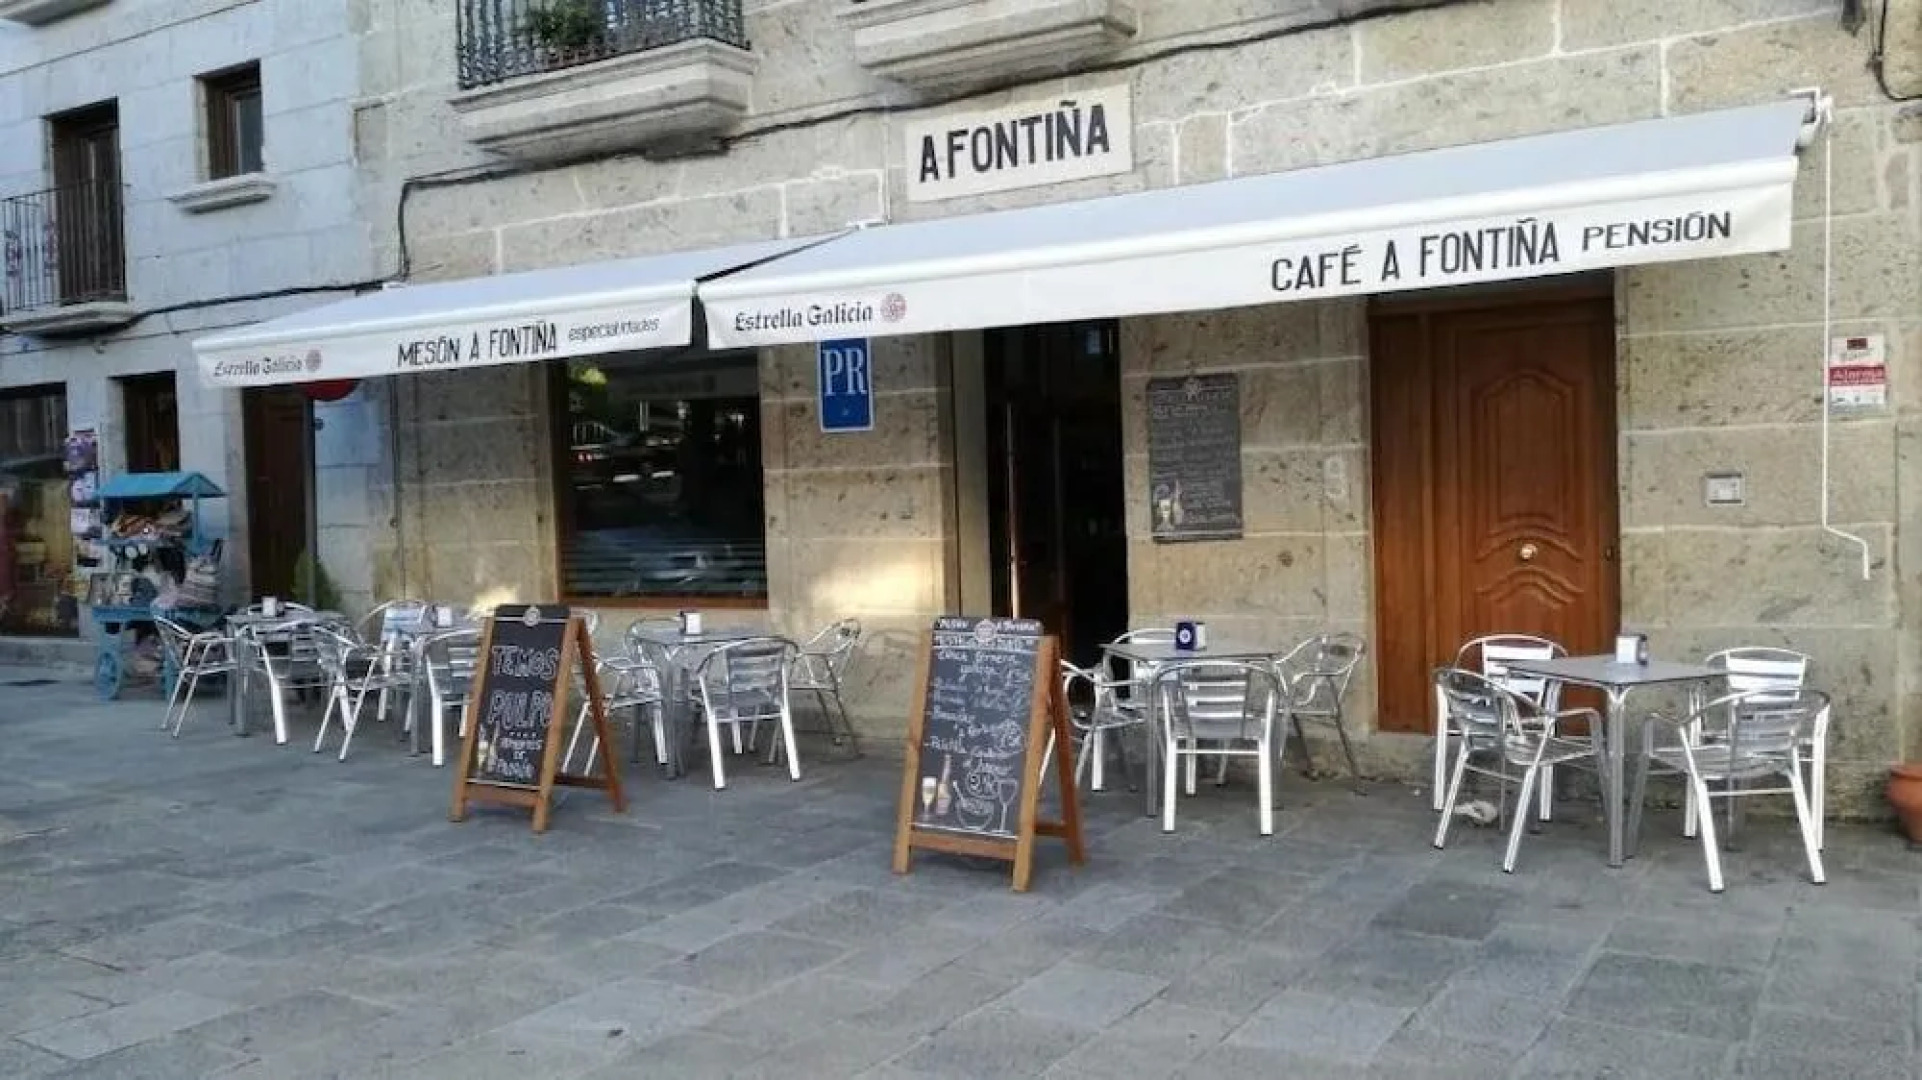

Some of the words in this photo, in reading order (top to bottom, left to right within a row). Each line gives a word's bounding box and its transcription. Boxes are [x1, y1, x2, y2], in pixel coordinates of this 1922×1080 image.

[920, 134, 940, 183] A
[946, 99, 1110, 179] FONTIÑA
[1271, 244, 1362, 291] CAFÉ
[1381, 239, 1400, 281] A
[1419, 216, 1560, 278] FONTIÑA
[1581, 210, 1732, 252] PENSIÓN
[734, 307, 803, 332] Estrella
[806, 301, 873, 326] Galicia
[397, 335, 460, 367] MESÓN
[468, 330, 480, 361] A
[489, 320, 557, 358] FONTIÑA
[823, 347, 867, 396] PR
